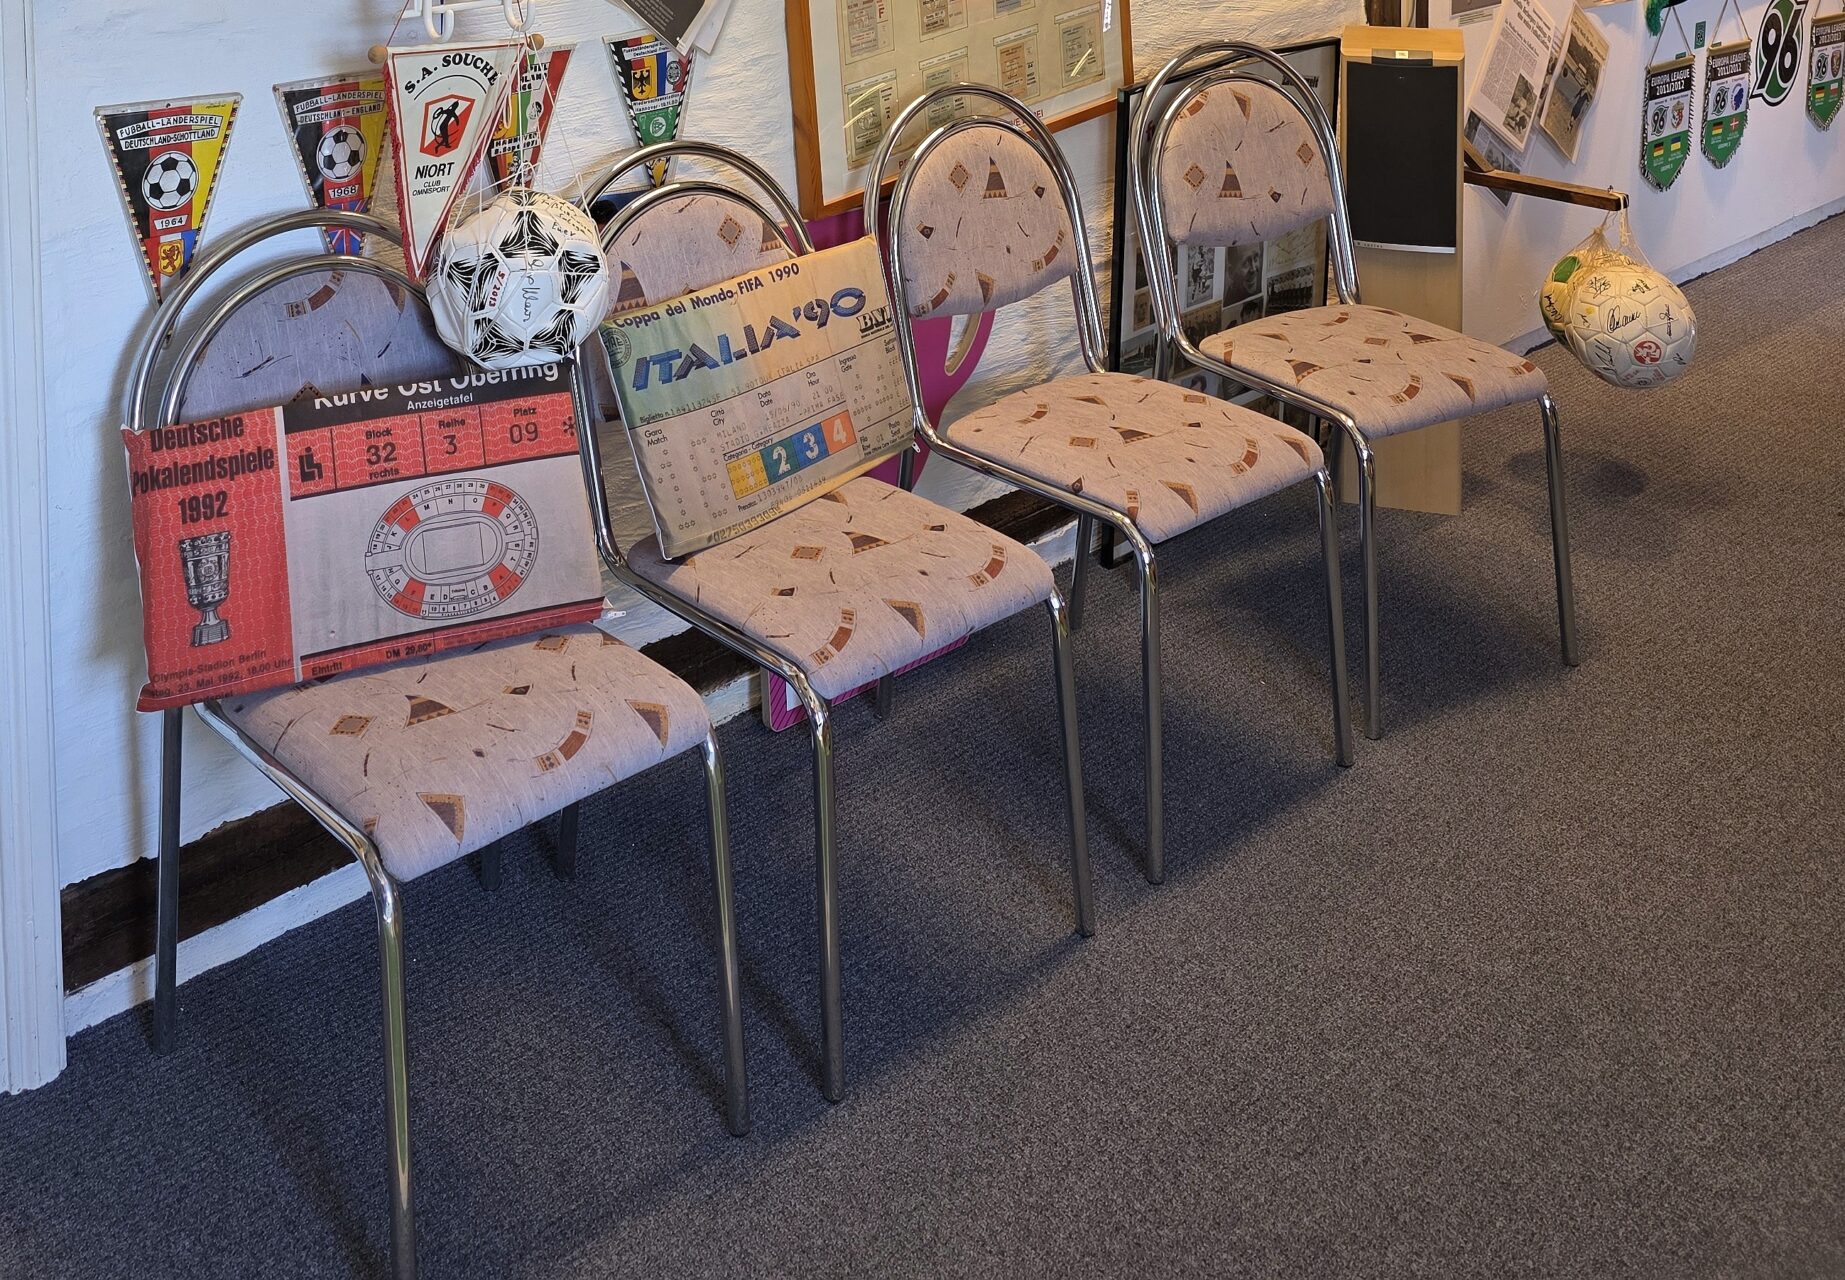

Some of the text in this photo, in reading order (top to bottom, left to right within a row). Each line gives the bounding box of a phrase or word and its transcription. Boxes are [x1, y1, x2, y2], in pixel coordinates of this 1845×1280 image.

[1713, 52, 1747, 68] EUROPA LEAGUE
[1651, 69, 1690, 86] EUROPA LEAGUE
[1717, 65, 1742, 76] 2011/2012
[404, 66, 438, 94] S.A.
[1656, 84, 1685, 96] 2011/2012
[125, 129, 215, 149] DEUTSCHLAND-SCHOTTLAND
[415, 162, 455, 180] NIORT
[332, 185, 357, 197] 1968
[412, 186, 450, 197] OMNISPORT
[423, 180, 441, 188] CLUB
[160, 217, 183, 228] 1964
[489, 271, 506, 307] 5/2013
[612, 262, 800, 329] Coppa del Mondo FIFA 1990
[838, 354, 857, 366] Ingresso
[806, 371, 816, 380] Ora
[807, 378, 820, 387] Hour
[406, 392, 474, 411] Anzeigetafel
[757, 390, 771, 400] Data
[760, 398, 774, 407] Date
[710, 408, 725, 418] Città
[365, 406, 537, 440] Block Reihe Platz
[712, 417, 725, 427] City
[716, 422, 747, 438] MILANO
[151, 416, 244, 452] Deutsche
[644, 428, 663, 437] Gara
[366, 421, 539, 466] 32 3 09
[647, 435, 668, 447] Match
[773, 419, 847, 476] 2 3 4
[723, 438, 774, 461] Categoria Category
[132, 446, 275, 497] Pokalendspiele
[368, 467, 400, 481] rechts
[178, 490, 229, 525] 1992
[385, 648, 401, 659] DM
[152, 649, 267, 684] Olympia-Stadion Berlin
[196, 678, 214, 690] Mai
[274, 658, 292, 669] Uhr
[311, 661, 343, 677] Eintritt
